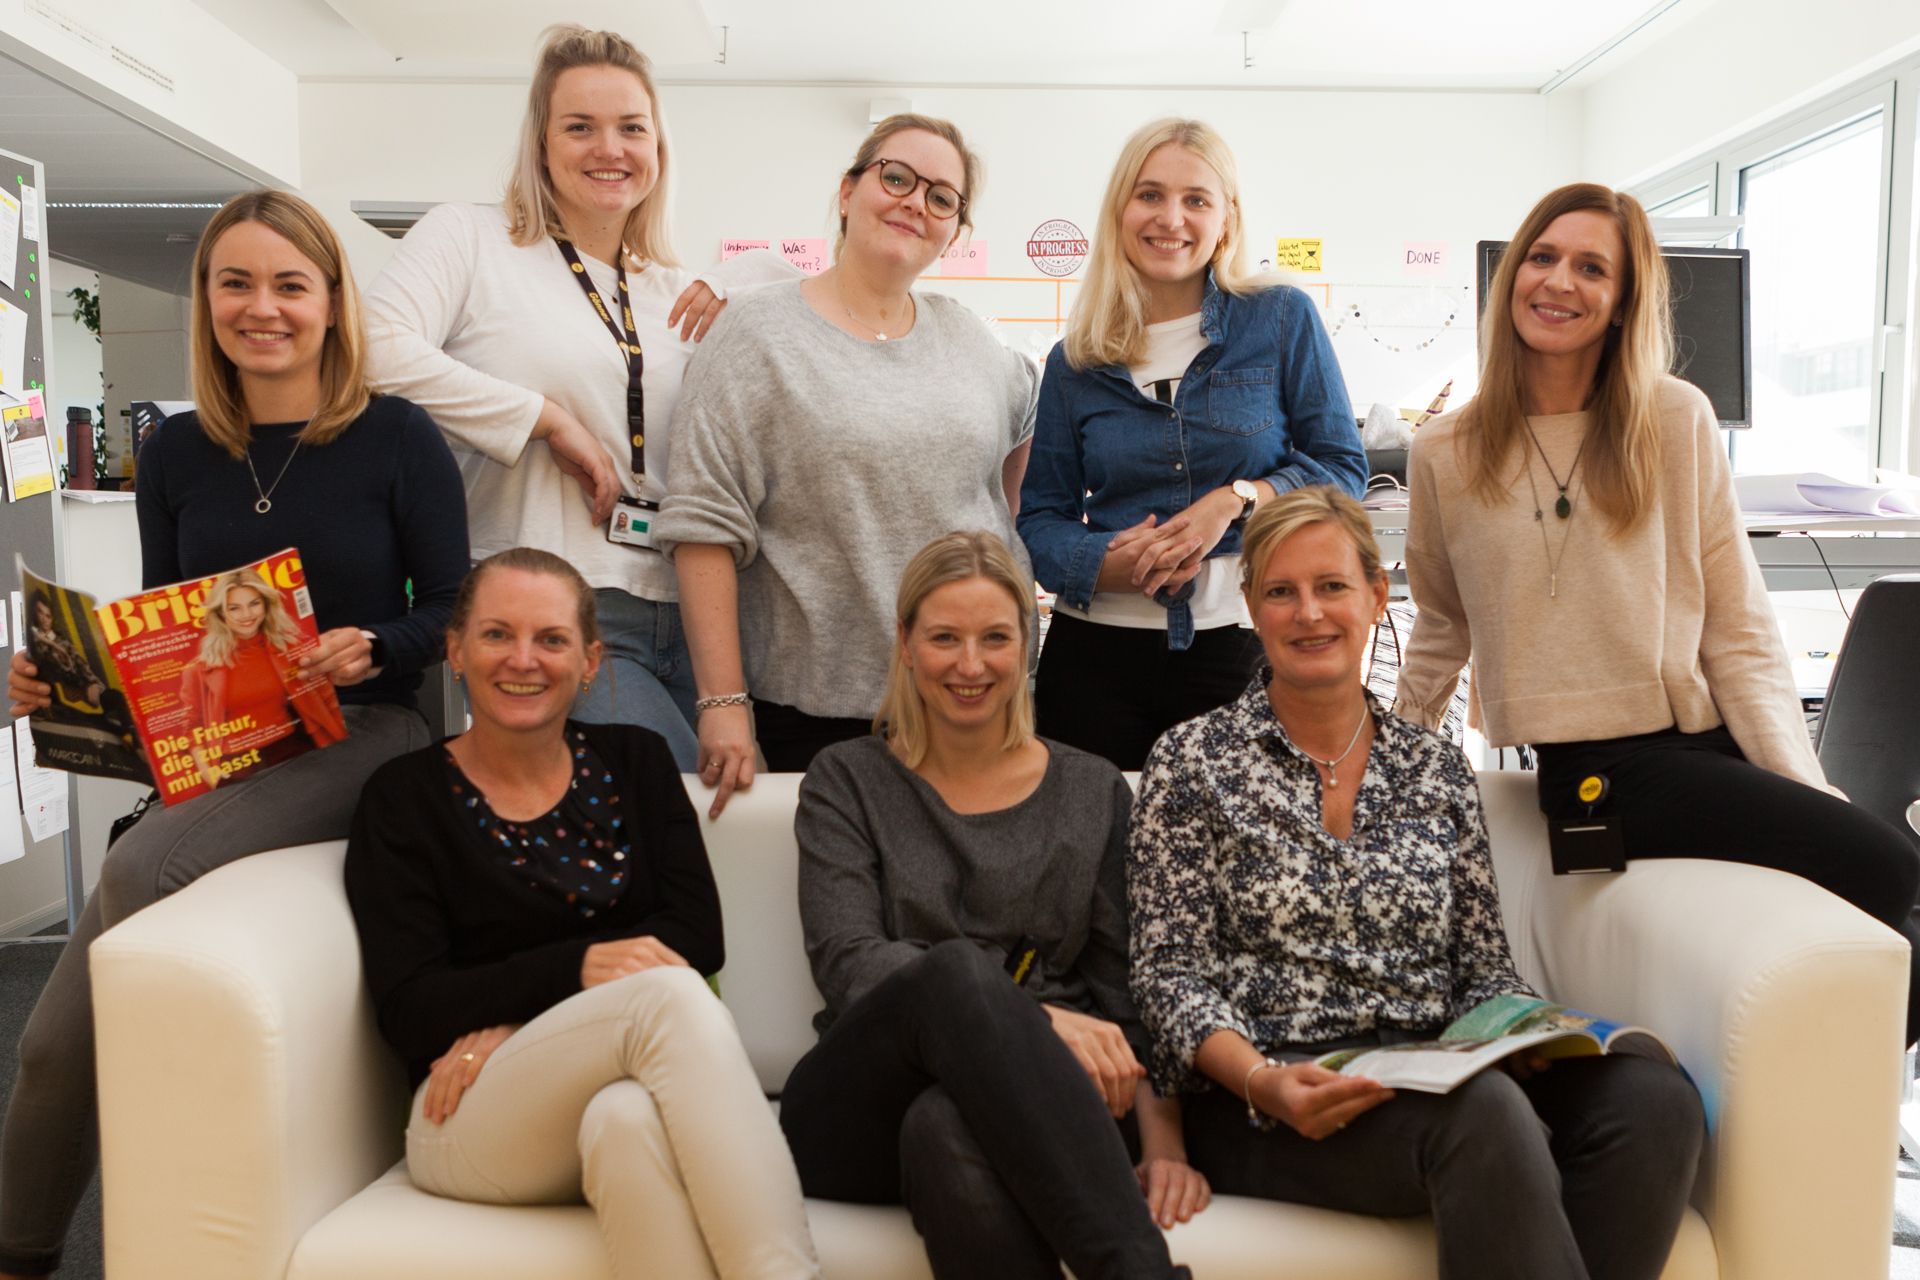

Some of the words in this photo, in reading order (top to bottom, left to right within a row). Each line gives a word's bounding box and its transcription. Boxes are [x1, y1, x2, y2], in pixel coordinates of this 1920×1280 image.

[1036, 229, 1044, 238] IN
[1044, 222, 1079, 237] PROGRESS
[782, 242, 807, 254] WAS
[1028, 242, 1040, 255] IN
[1040, 241, 1087, 255] PROGRESS
[1406, 250, 1441, 265] DONE
[1045, 259, 1080, 274] PROGRESS
[153, 735, 190, 759] Die
[192, 714, 257, 745] Frisur,
[160, 753, 194, 777] die
[198, 745, 223, 763] zu
[167, 769, 203, 795] mir
[207, 747, 262, 785] passt
